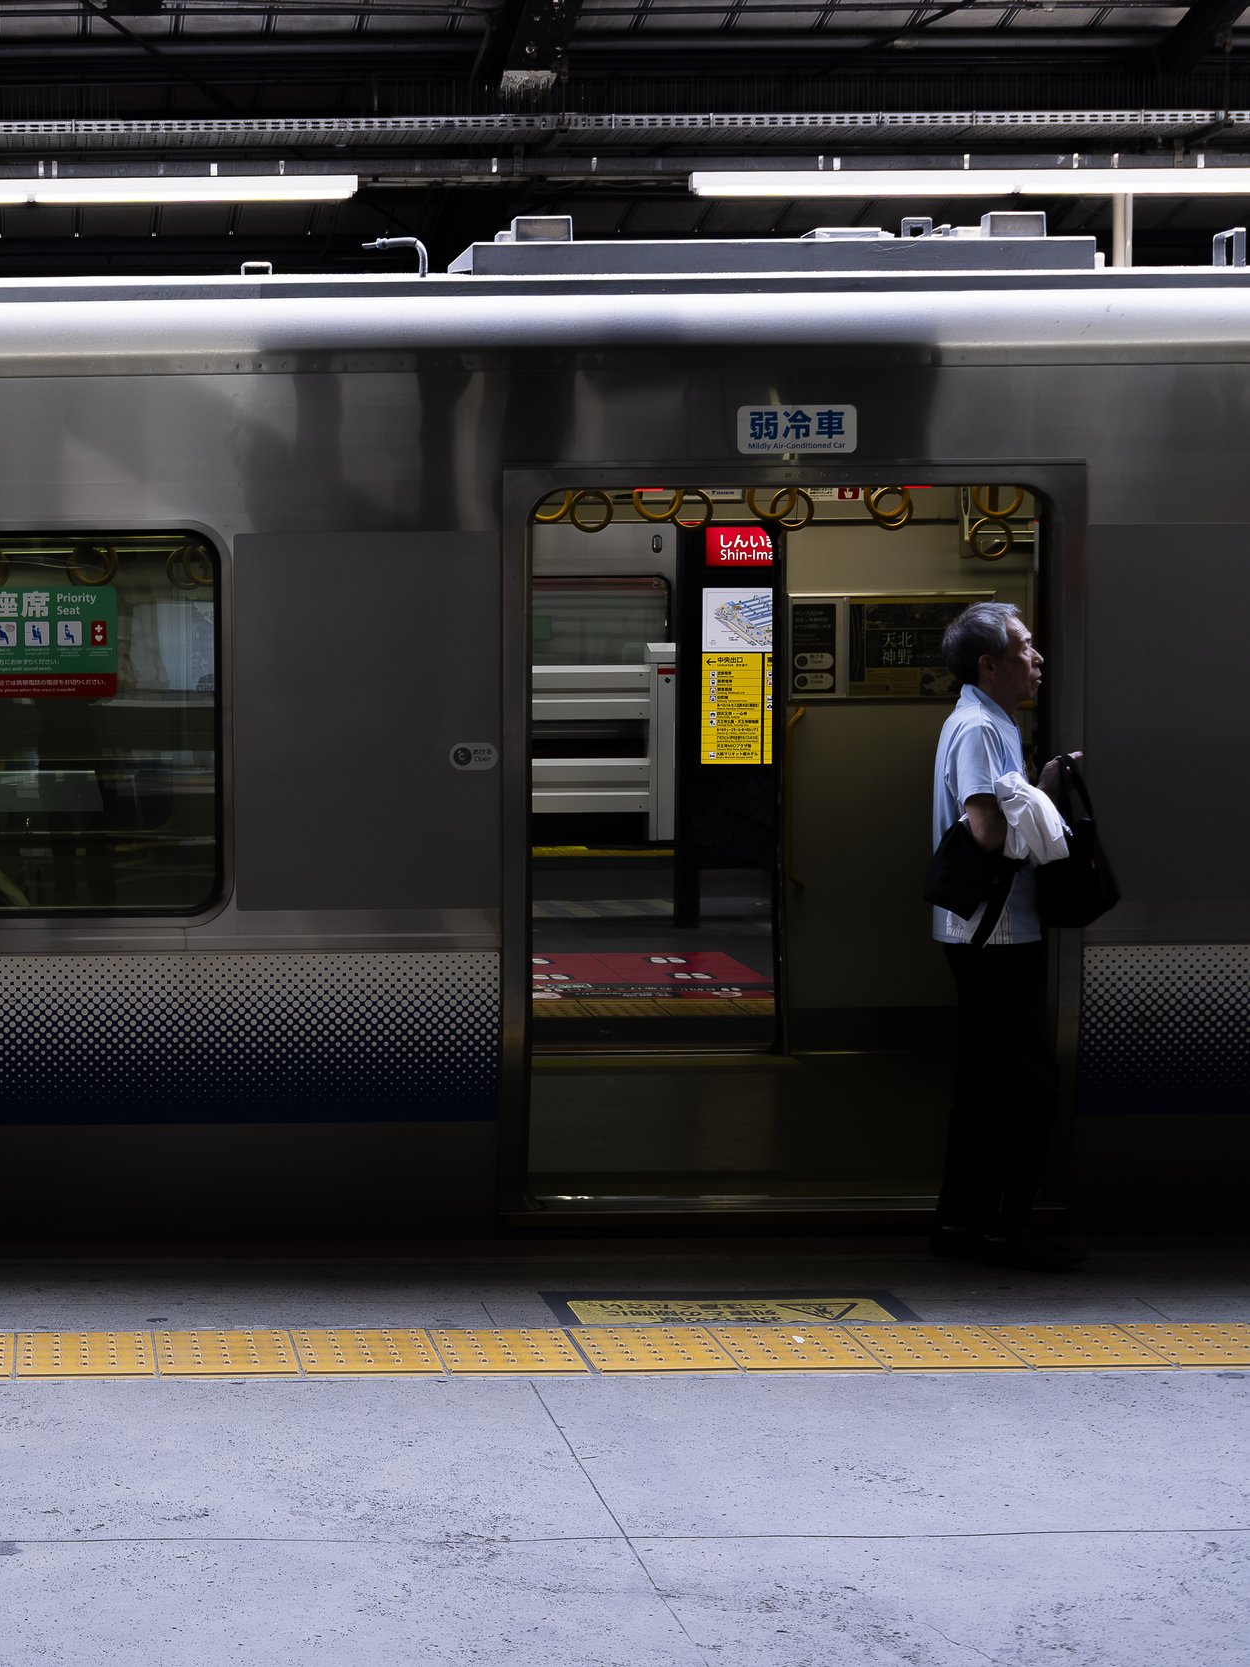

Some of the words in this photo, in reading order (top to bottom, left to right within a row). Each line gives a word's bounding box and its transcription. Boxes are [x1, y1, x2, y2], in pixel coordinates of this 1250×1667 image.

[749, 409, 845, 440] 弱冷車
[56, 593, 97, 605] Priority
[56, 605, 81, 615] Seat
